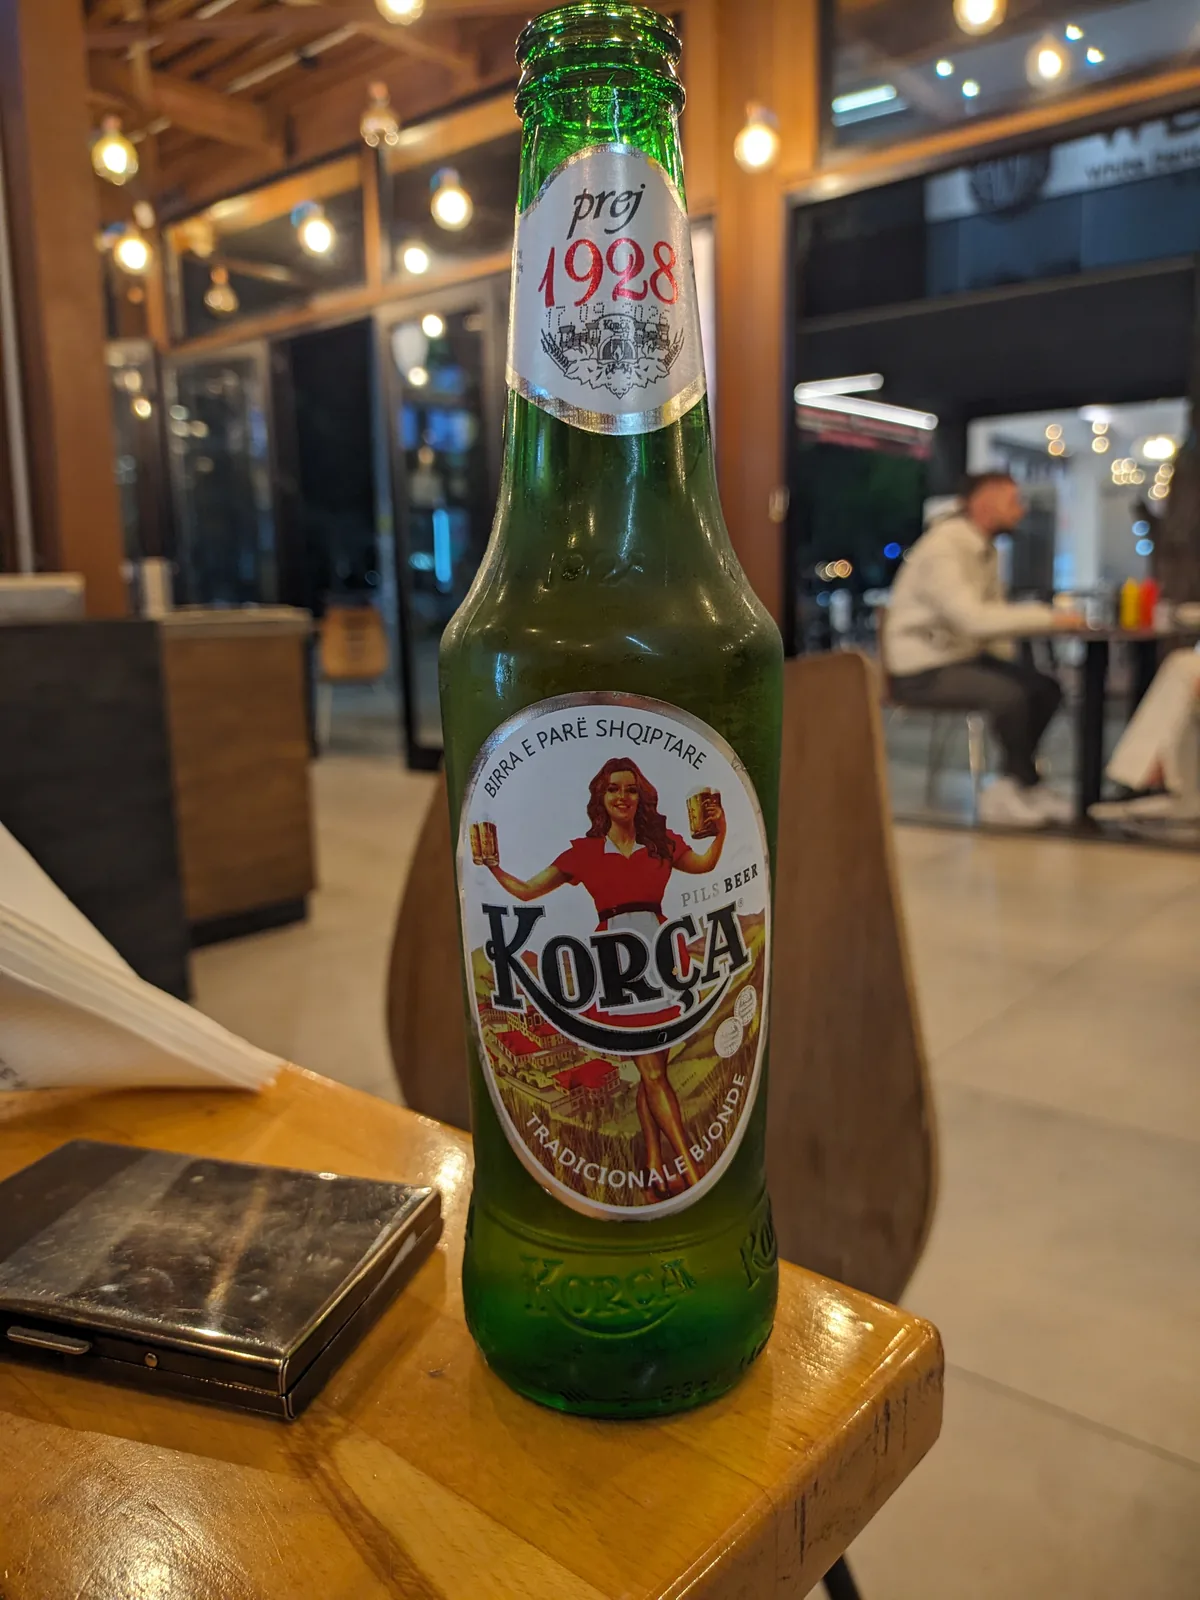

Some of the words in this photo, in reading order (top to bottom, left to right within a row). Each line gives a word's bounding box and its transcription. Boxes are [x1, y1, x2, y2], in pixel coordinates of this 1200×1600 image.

[567, 184, 646, 240] prej
[538, 238, 679, 308] 1928
[484, 751, 523, 798] BIRRA
[521, 739, 536, 757] E
[537, 717, 589, 749] PARË
[596, 719, 707, 770] SHQIPTARE
[680, 883, 720, 907] PILS
[723, 863, 758, 893] BEER
[482, 901, 752, 1014] KORÇA
[526, 1112, 687, 1189] TRADICIONALE
[691, 1073, 746, 1162] BJONDE
